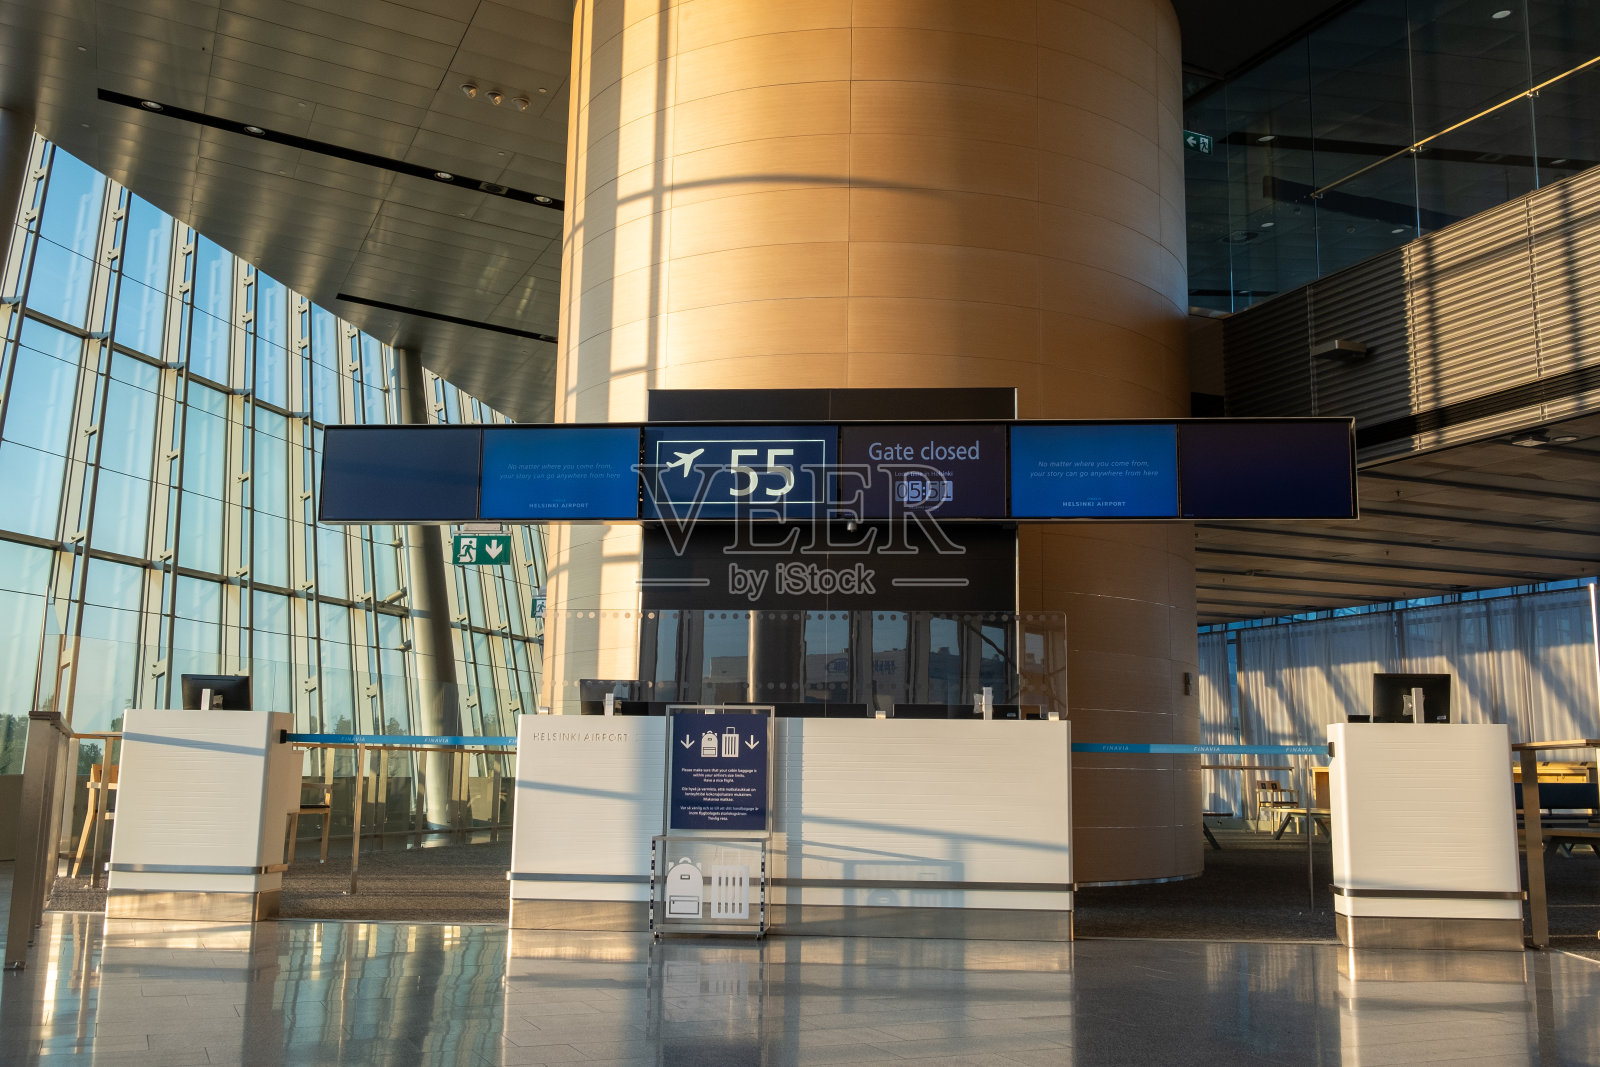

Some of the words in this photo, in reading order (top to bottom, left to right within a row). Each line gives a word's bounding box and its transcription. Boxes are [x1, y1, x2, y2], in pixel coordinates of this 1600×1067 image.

[868, 442, 914, 460] Gate
[920, 440, 980, 460] closed
[729, 448, 796, 497] 55
[896, 481, 953, 501] 05:51
[533, 732, 580, 742] HELSINKI
[583, 733, 629, 742] AIRPORT
